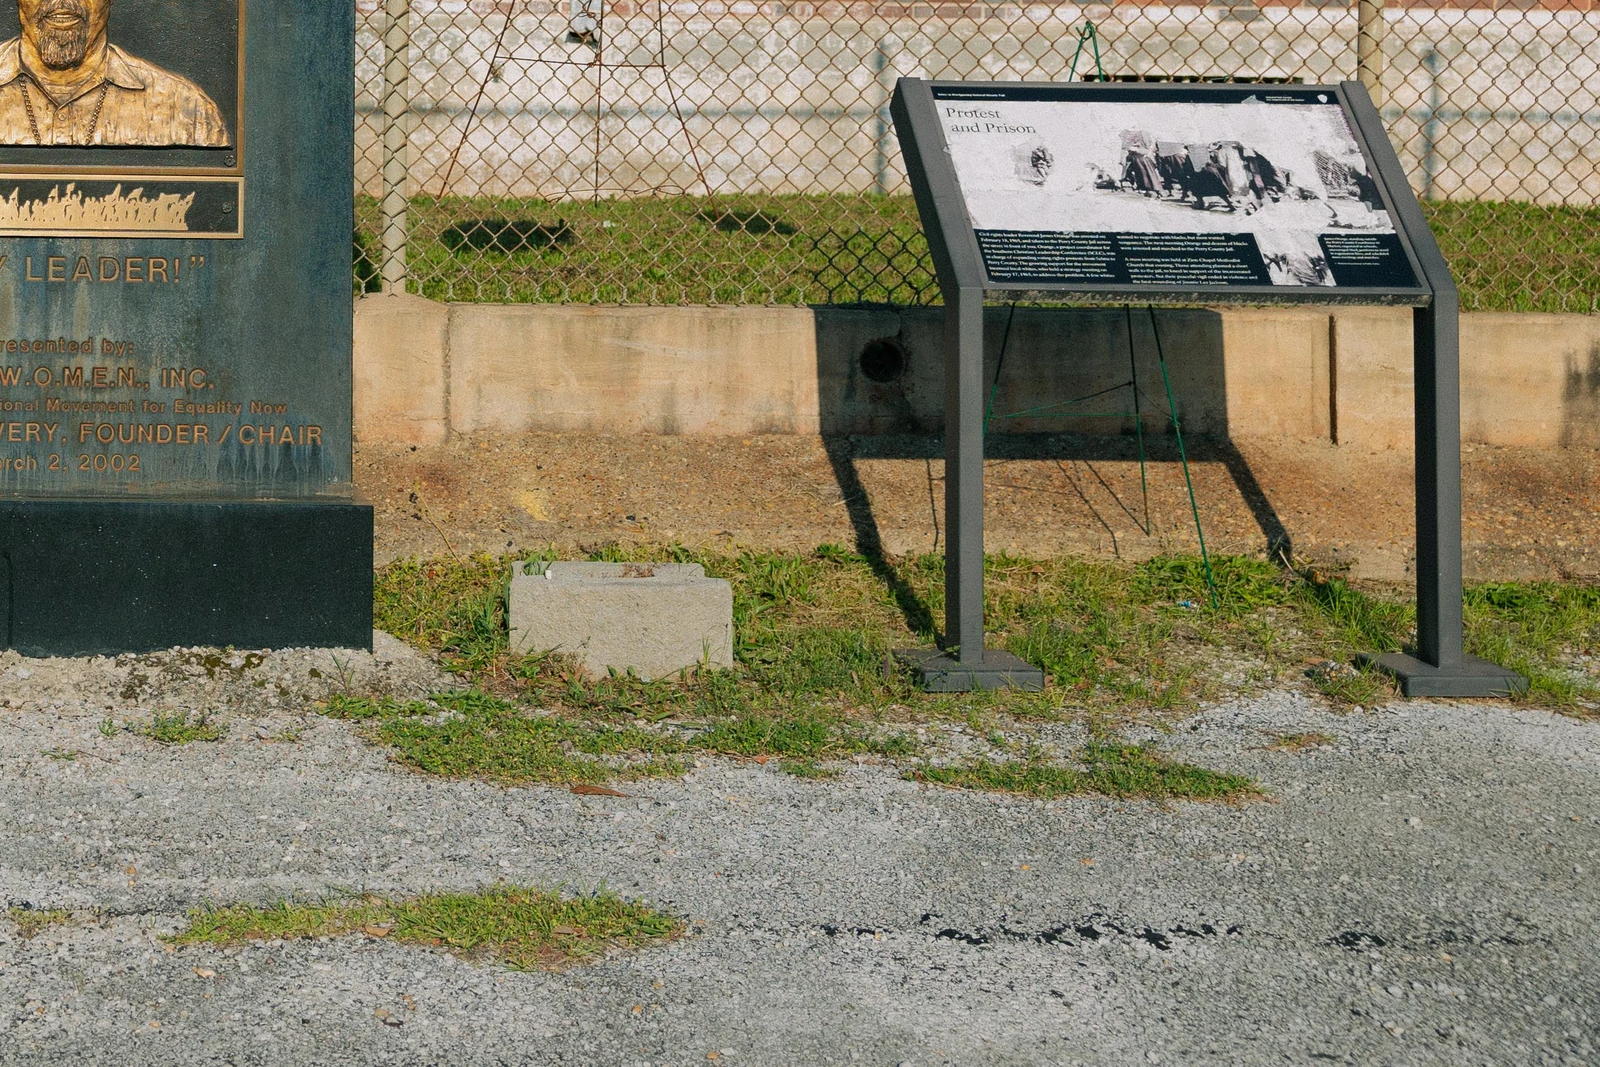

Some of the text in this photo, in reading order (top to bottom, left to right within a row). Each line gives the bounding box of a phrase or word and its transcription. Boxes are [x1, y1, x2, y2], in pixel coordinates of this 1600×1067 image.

[946, 108, 1002, 118] Protest
[952, 123, 1036, 133] and Prison
[101, 337, 135, 358] by:
[161, 368, 215, 389] INC.
[46, 397, 135, 414] Movement
[143, 398, 166, 414] for
[174, 399, 242, 417] Equality
[250, 400, 288, 414] Now
[47, 454, 67, 474] 2,
[77, 453, 141, 471] 2002
